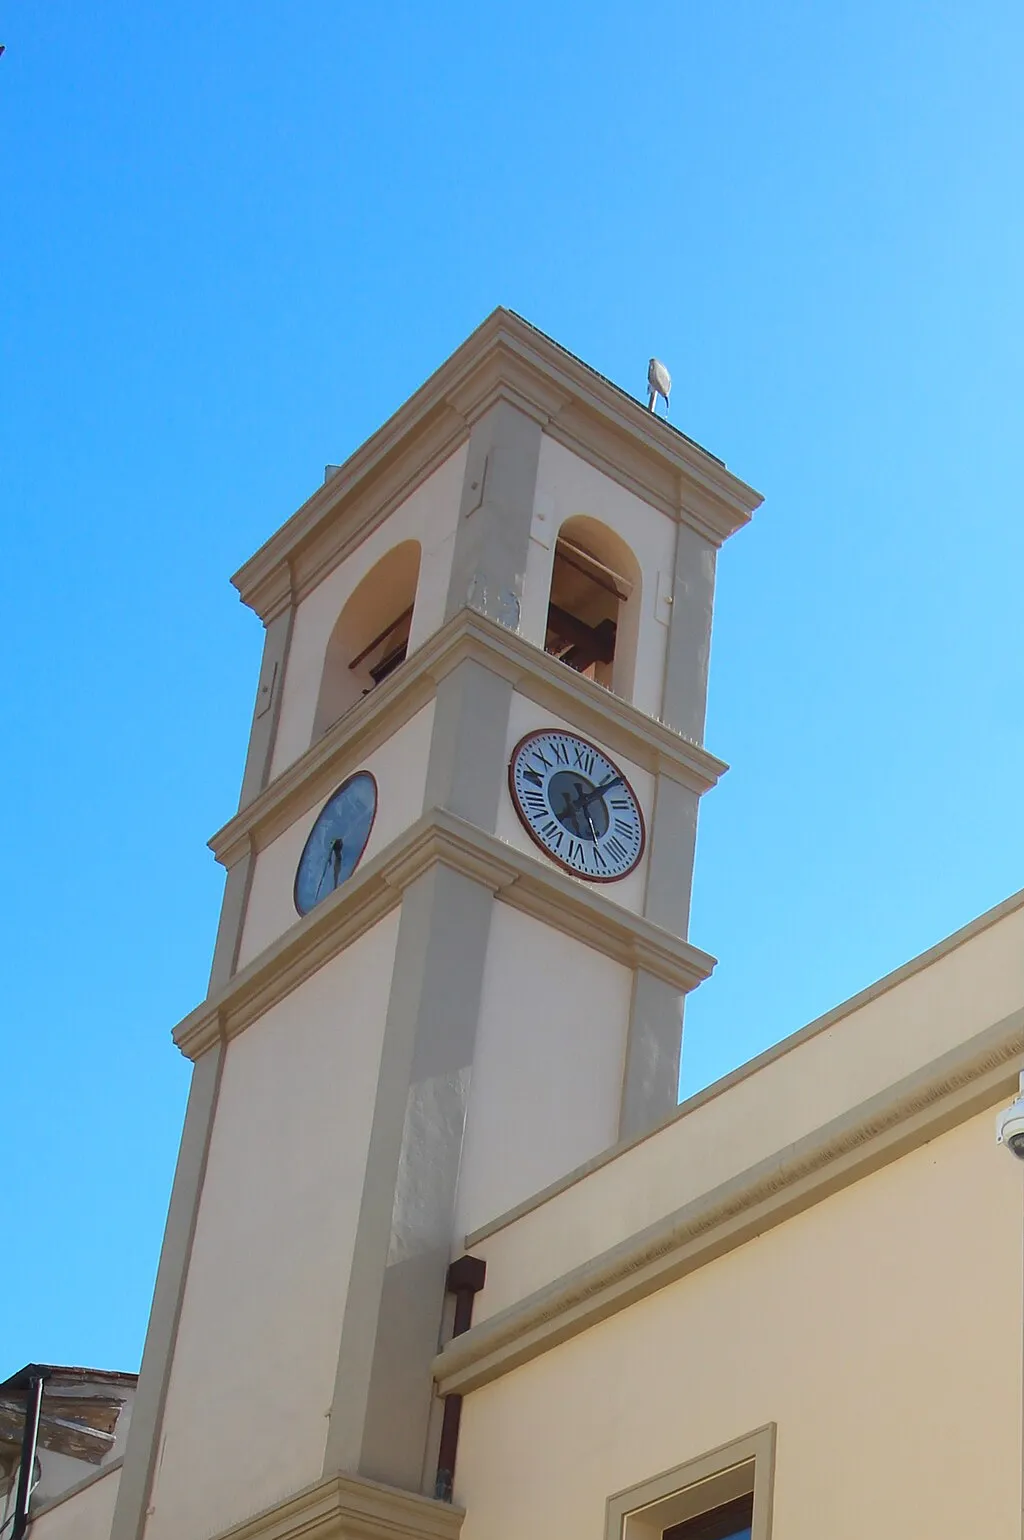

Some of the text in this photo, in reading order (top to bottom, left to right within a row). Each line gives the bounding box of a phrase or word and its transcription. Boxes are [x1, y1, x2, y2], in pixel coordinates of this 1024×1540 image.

[532, 748, 552, 772] X
[550, 743, 570, 765] XI
[573, 746, 595, 776] XII
[610, 800, 630, 810] II
[541, 820, 564, 849] VII
[614, 818, 634, 840] III
[568, 839, 585, 865] VI
[592, 846, 607, 868] V
[602, 835, 628, 864] IIII
